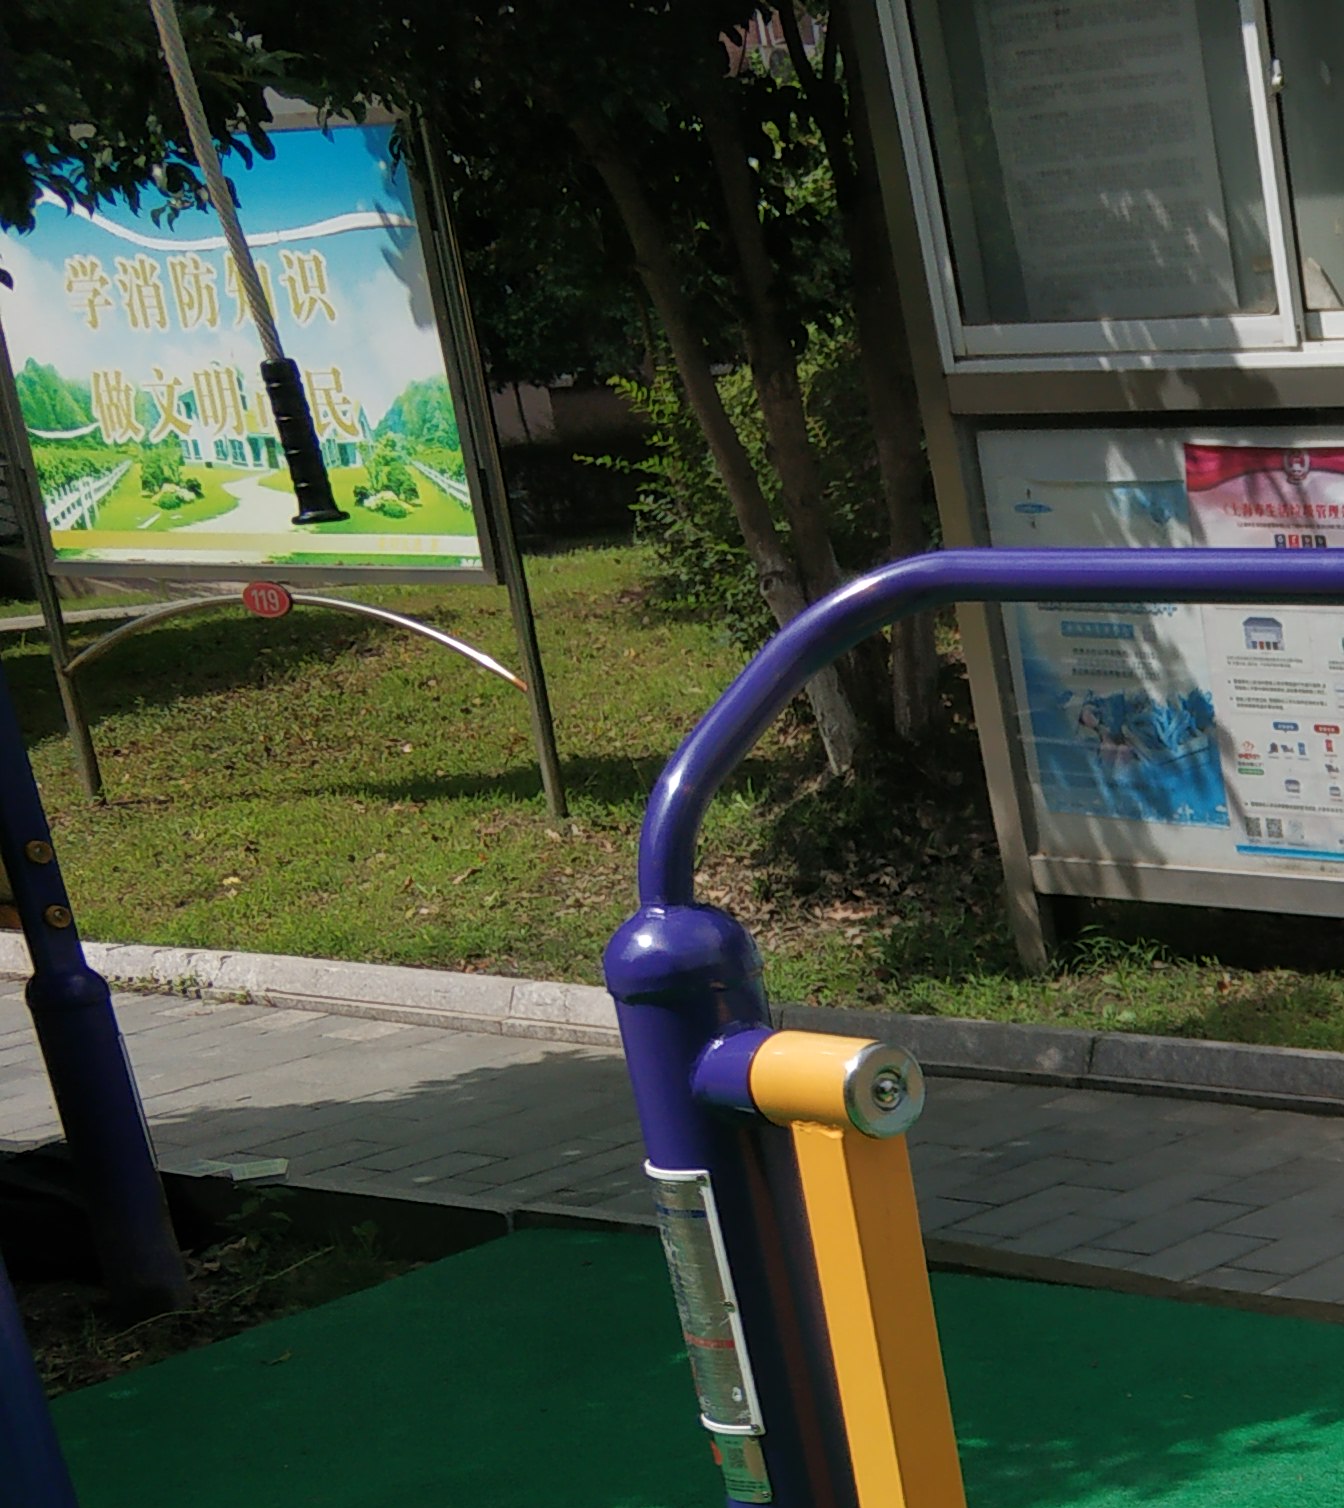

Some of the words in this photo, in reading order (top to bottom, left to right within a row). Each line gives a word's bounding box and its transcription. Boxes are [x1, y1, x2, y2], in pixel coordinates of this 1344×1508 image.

[91, 366, 361, 446] 做文明民
[250, 588, 281, 612] 119
